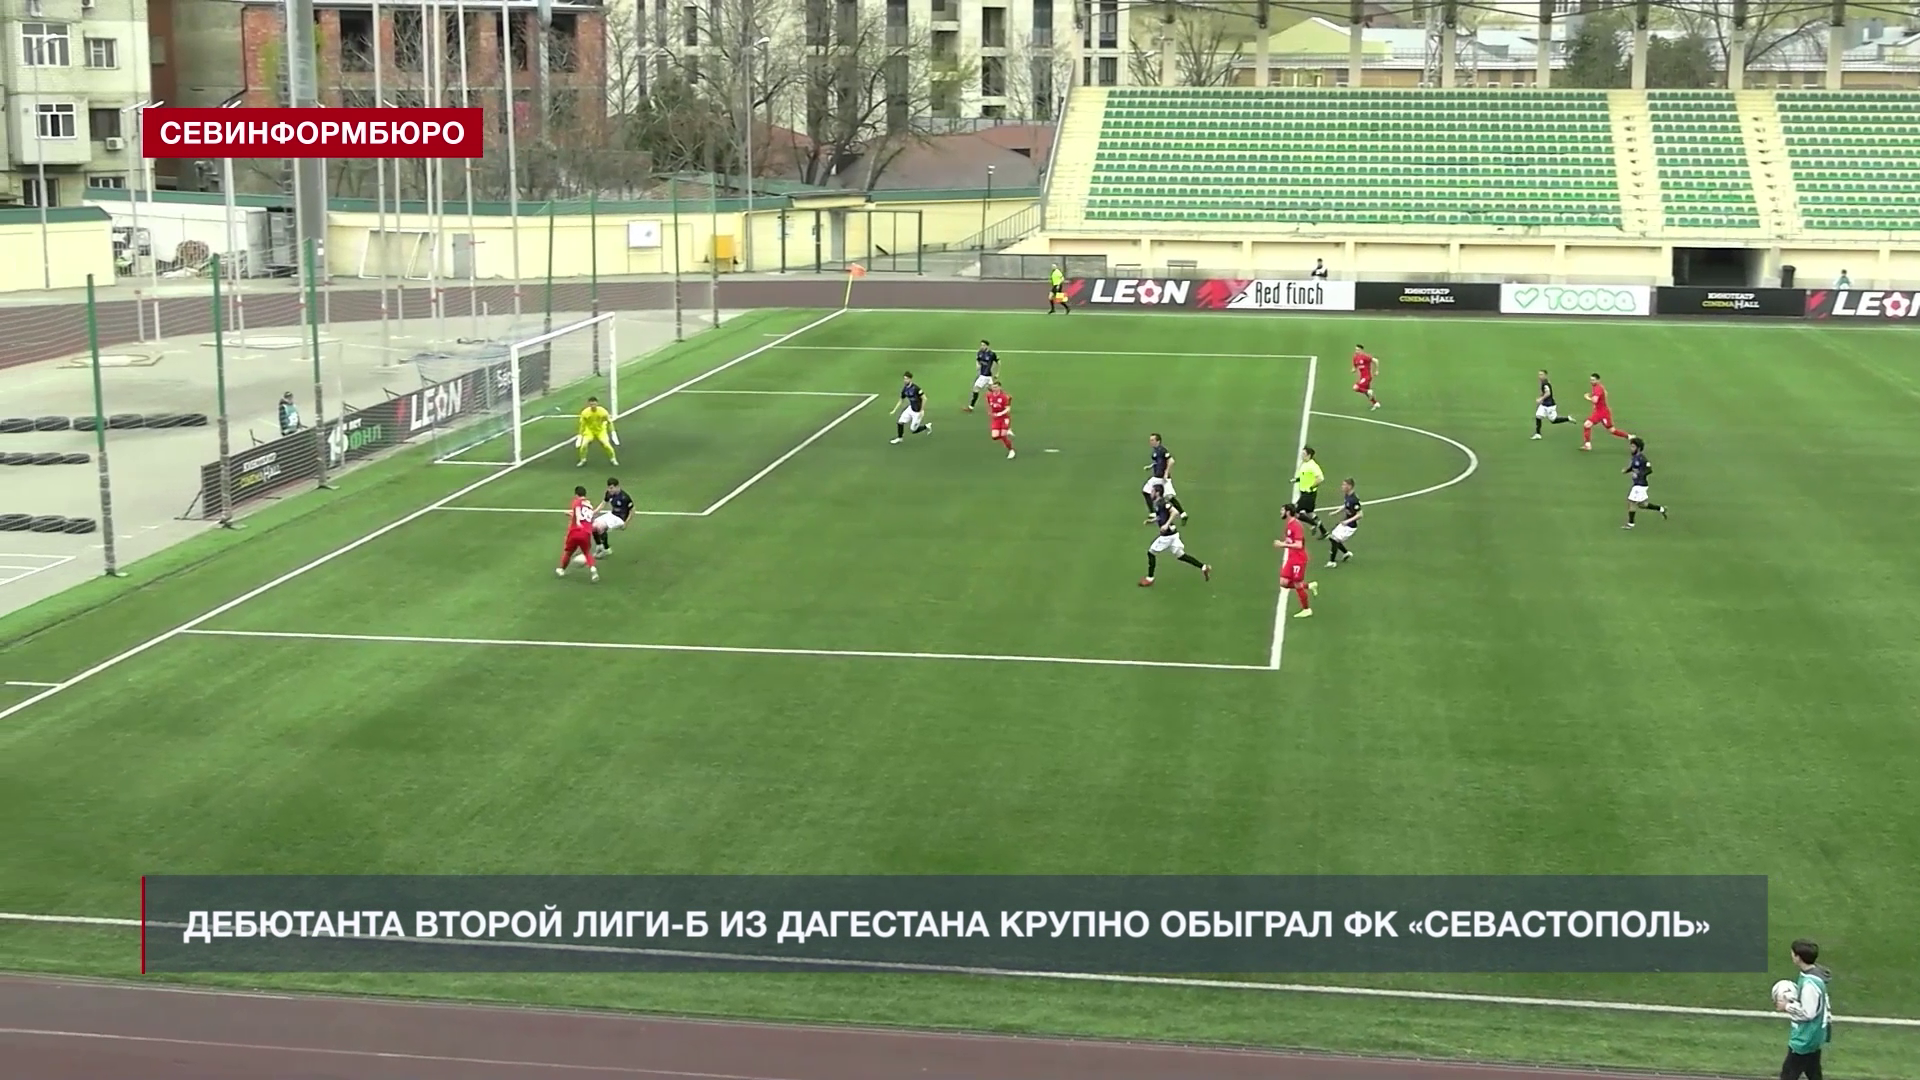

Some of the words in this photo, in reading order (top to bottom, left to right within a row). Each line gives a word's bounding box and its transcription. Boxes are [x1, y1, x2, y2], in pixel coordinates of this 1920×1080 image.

[1091, 279, 1191, 304] LEON
[1255, 281, 1281, 307] Red
[1286, 282, 1324, 305] finch
[410, 379, 463, 431] LEON
